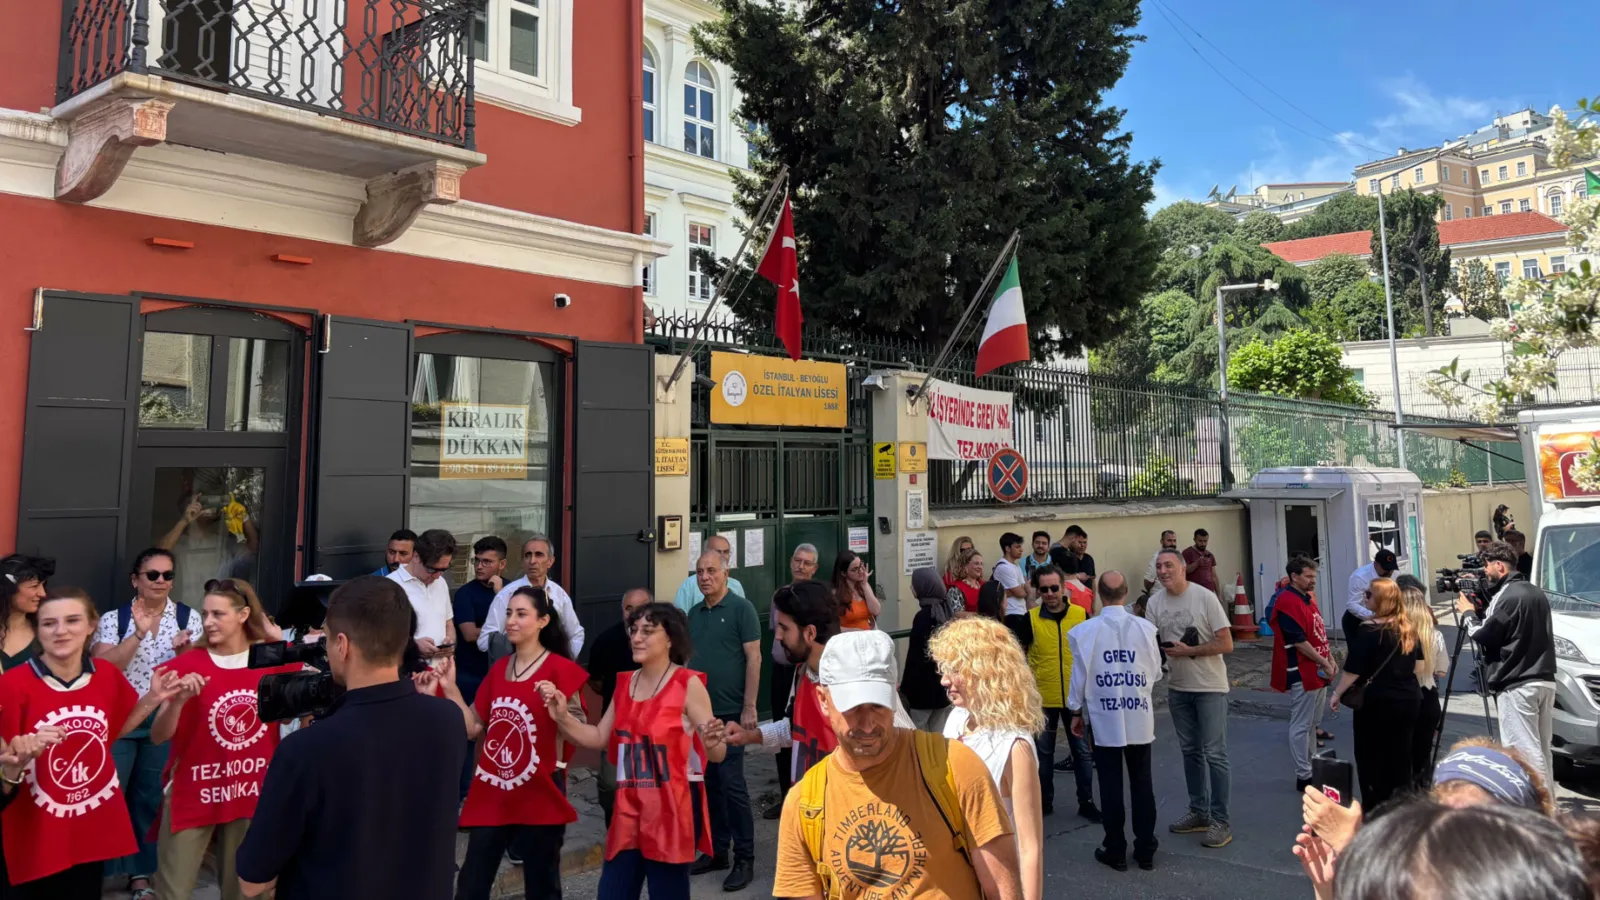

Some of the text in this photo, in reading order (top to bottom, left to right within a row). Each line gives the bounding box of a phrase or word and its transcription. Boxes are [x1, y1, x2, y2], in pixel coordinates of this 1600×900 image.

[763, 369, 795, 382] İSTANBUL
[800, 373, 829, 384] BEYOĞLU
[752, 382, 839, 399] ÖZEL İTALYAN LİSESİ
[447, 408, 524, 429] KİRALIK
[937, 386, 975, 428] İŞYERİNDE
[976, 402, 996, 430] GREV
[446, 434, 523, 456] DÜKKAN
[1095, 670, 1148, 688] GÖZCÜSÜ
[500, 746, 513, 764] tk
[71, 761, 90, 784] tk
[833, 802, 912, 841] TIMBERLAND
